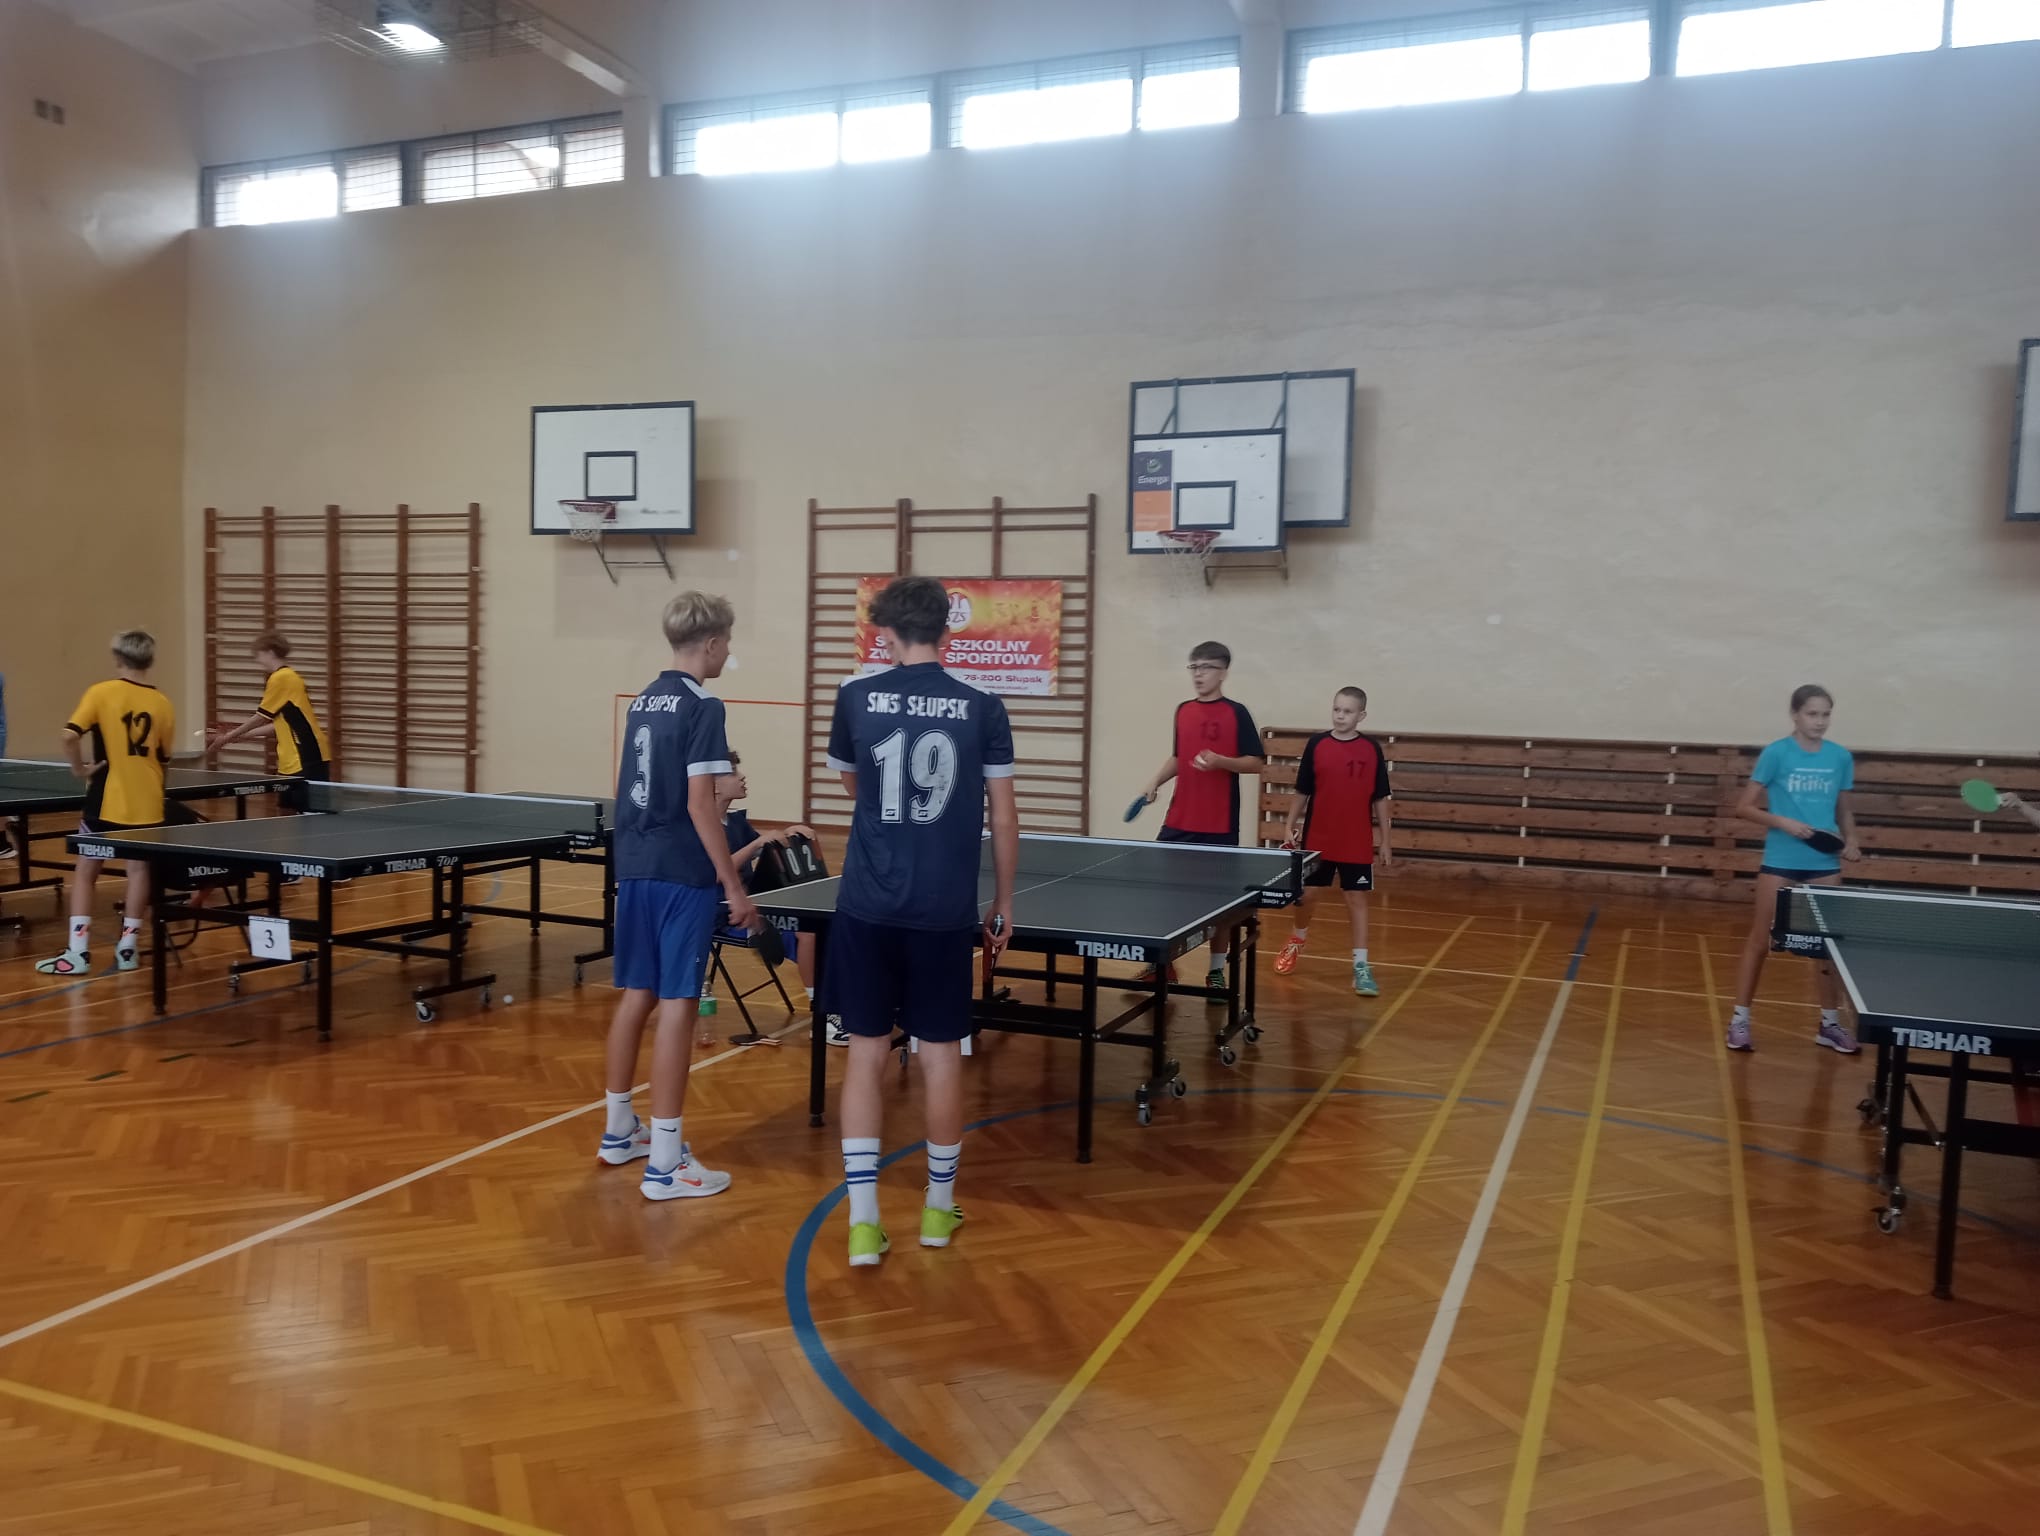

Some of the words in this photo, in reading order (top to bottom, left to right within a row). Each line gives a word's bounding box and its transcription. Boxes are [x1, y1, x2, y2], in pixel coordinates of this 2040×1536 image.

[950, 639, 1031, 652] SZKOLNY
[945, 652, 1043, 665] SPORTOWY
[867, 691, 901, 714] SMS
[906, 695, 970, 720] SŁUPSK
[121, 710, 152, 757] 12
[628, 723, 651, 810] 3
[870, 728, 957, 824] 19
[233, 785, 265, 795] TIBHAR
[77, 842, 115, 858] TIBHAR
[280, 861, 325, 878] TIBHAR
[384, 857, 427, 872] TIBHAR
[264, 929, 275, 949] 3
[1784, 933, 1823, 944] TIBHAR
[1075, 940, 1145, 962] TIBHAR
[1892, 1027, 1992, 1055] TIBHAR
